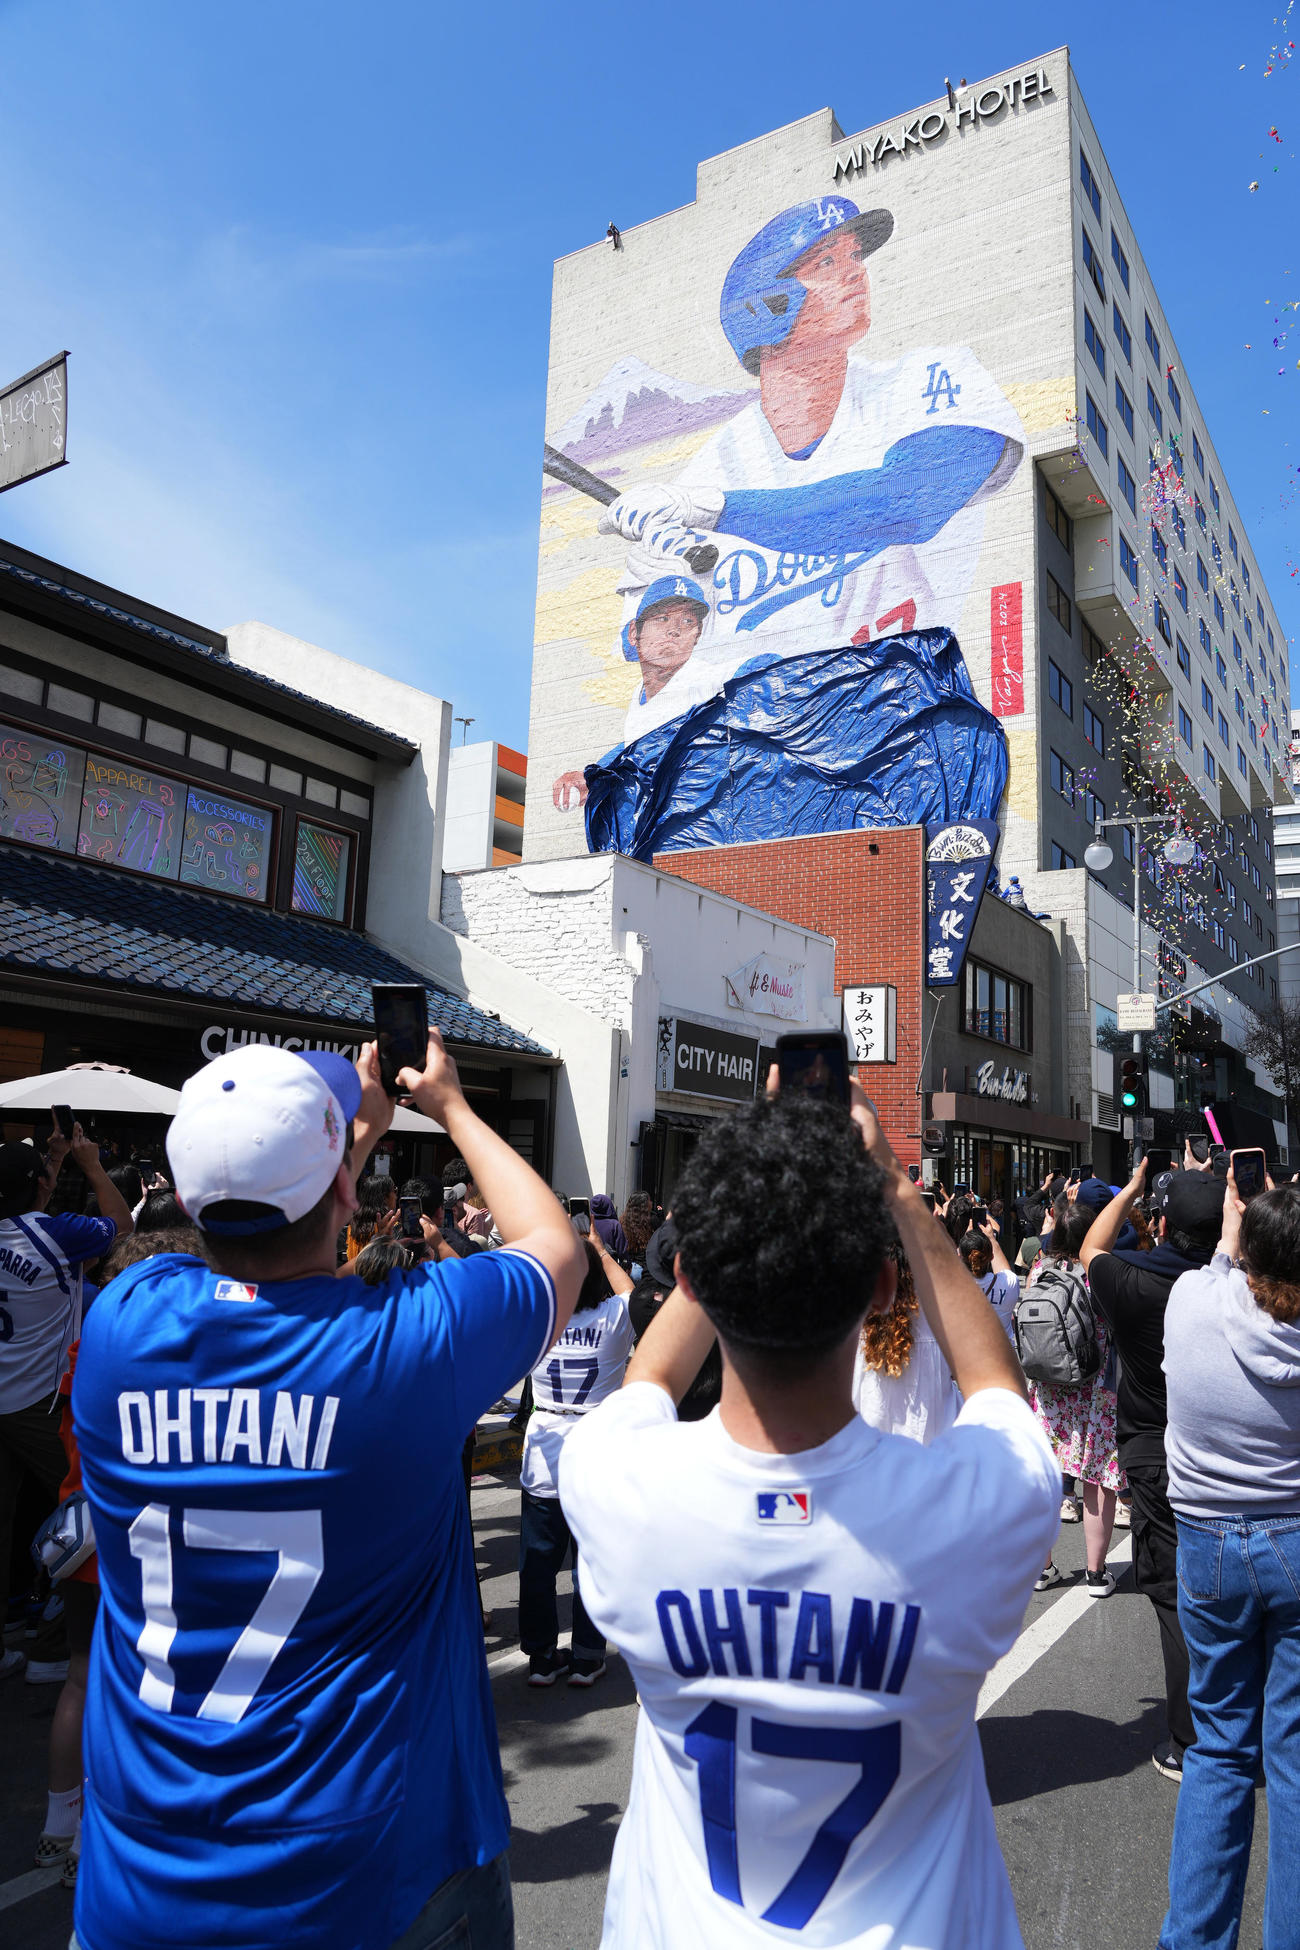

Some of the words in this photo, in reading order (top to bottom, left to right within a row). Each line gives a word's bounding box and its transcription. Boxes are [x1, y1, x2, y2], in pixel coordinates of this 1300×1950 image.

[832, 111, 946, 179] MIYAKO
[955, 69, 1053, 128] HOTEL
[813, 198, 845, 230] LA
[922, 361, 961, 415] LA
[674, 578, 688, 596] LA
[998, 592, 1008, 627] 2024
[0, 738, 32, 761] GS
[86, 760, 156, 797] APPAREL
[187, 793, 265, 832] ACCESSORIES
[296, 842, 316, 867] 2nd
[310, 866, 334, 900] Floor
[928, 871, 976, 979] 文化堂
[761, 973, 769, 993] &
[769, 975, 794, 999] Music
[856, 991, 875, 1059] おみやげ
[677, 1043, 716, 1074] CITY
[717, 1052, 754, 1082] HAIR
[546, 1357, 600, 1405] 17
[117, 1387, 341, 1470] OHTANI
[127, 1502, 325, 1725] 17
[655, 1588, 922, 1695] OHTANI
[683, 1699, 903, 1931] 17
